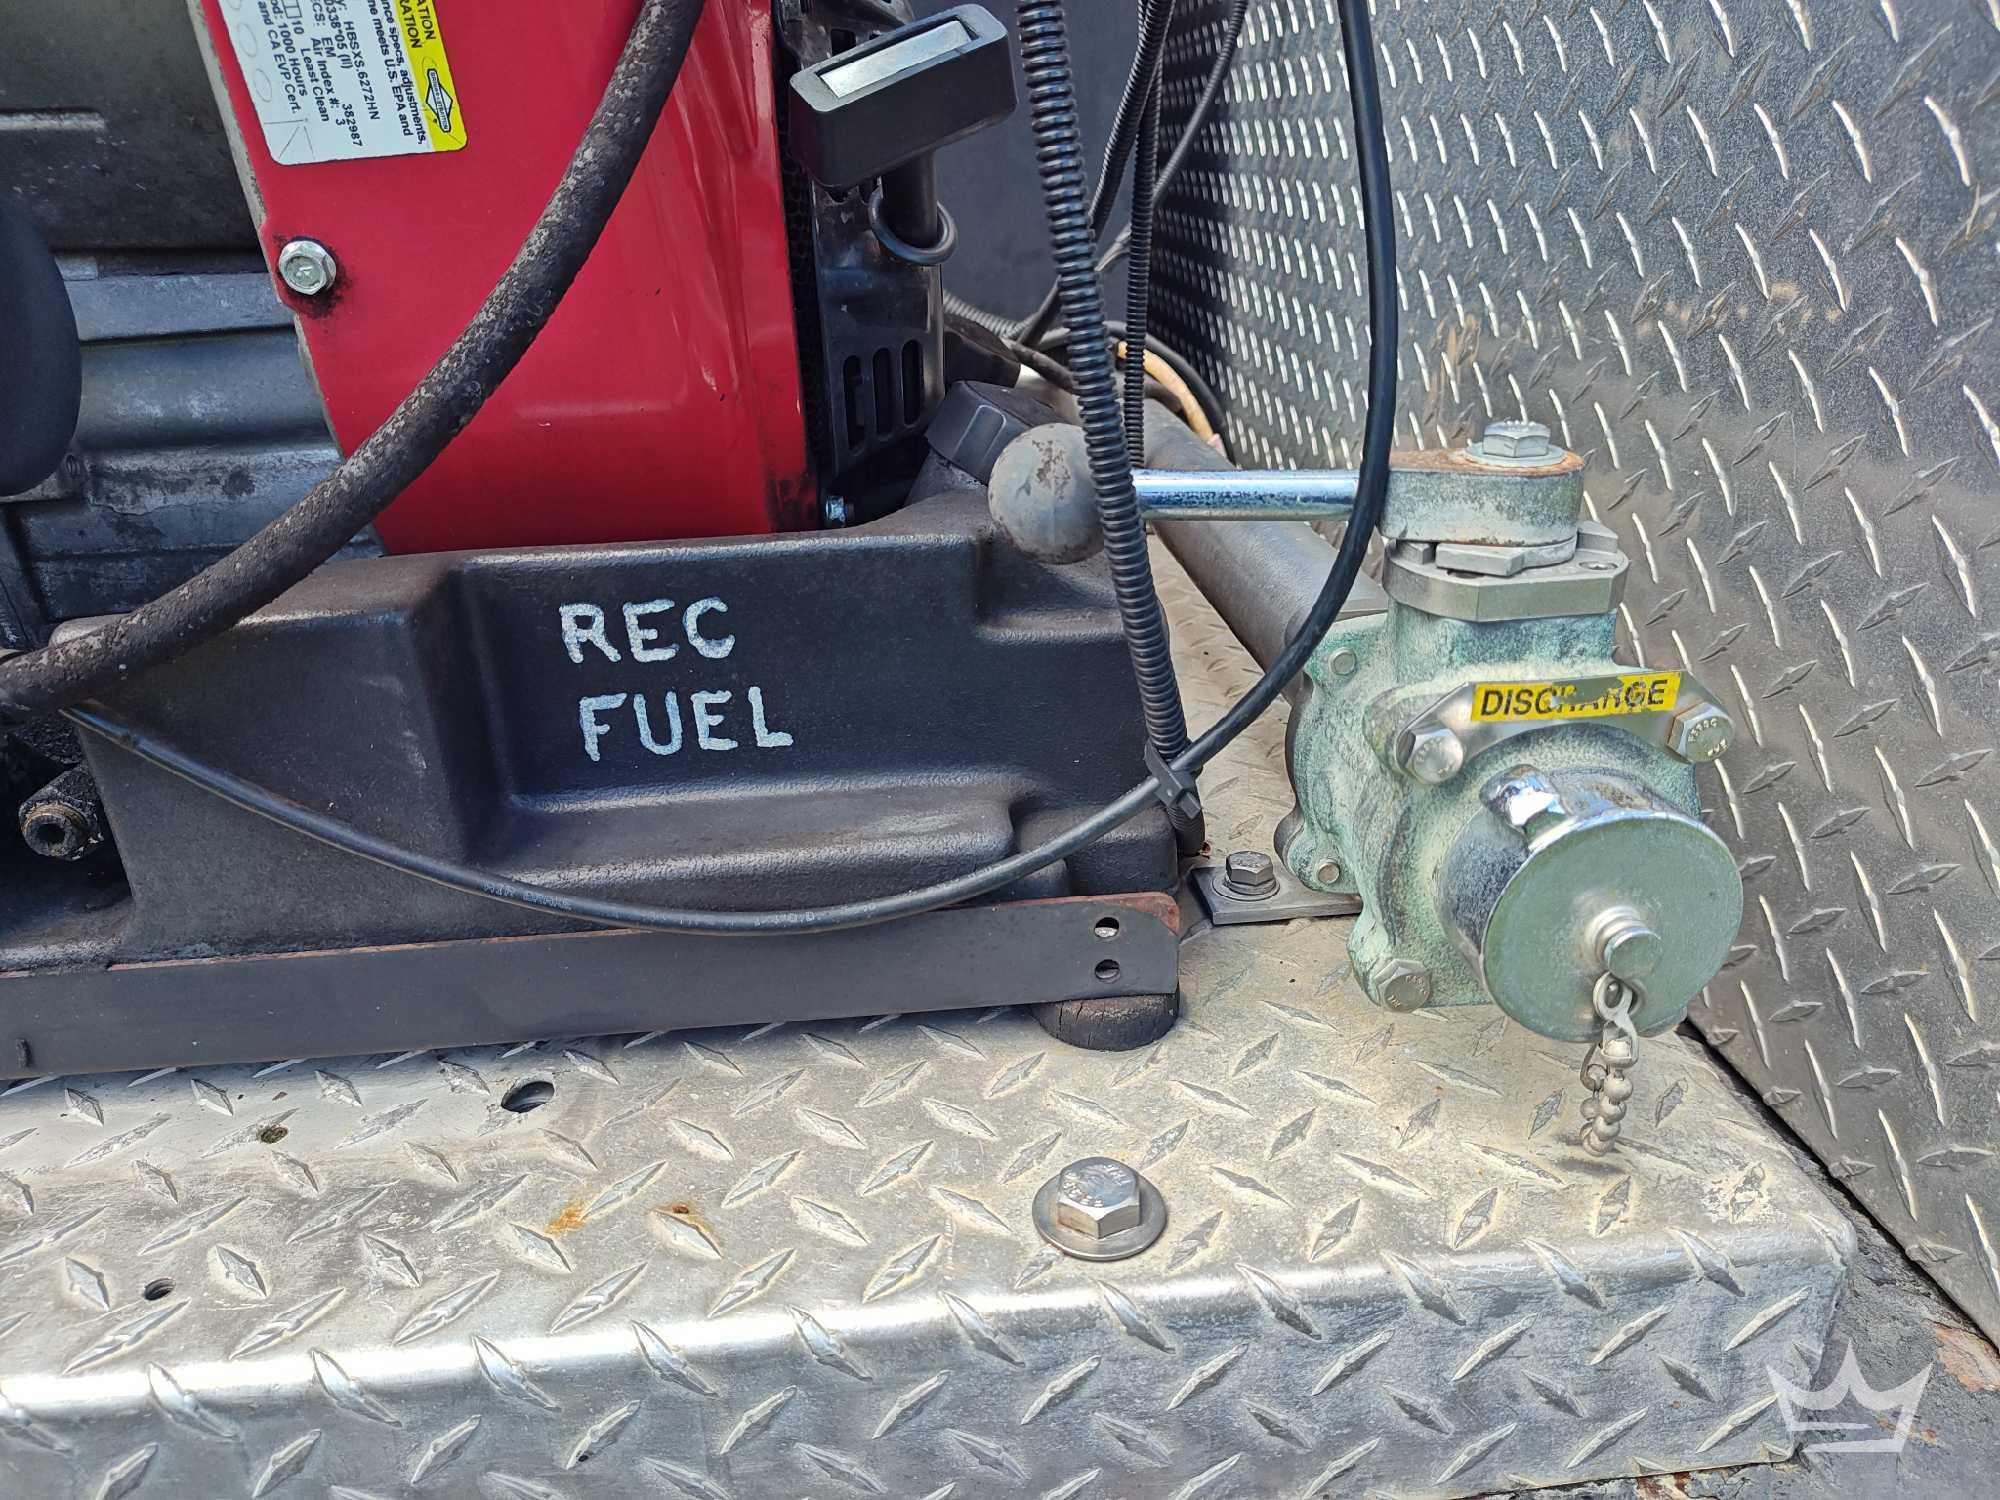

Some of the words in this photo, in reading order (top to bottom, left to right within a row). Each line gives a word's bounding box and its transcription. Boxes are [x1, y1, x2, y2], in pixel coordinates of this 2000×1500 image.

[258, 1, 273, 25] and
[311, 0, 326, 26] CS:
[321, 37, 336, 57] EM
[268, 29, 281, 50] CA
[372, 18, 389, 56] meets
[274, 54, 292, 80] EVP
[278, 22, 297, 54] 1000
[288, 58, 308, 97] Hours
[292, 21, 305, 35] 10
[300, 48, 321, 82] Least
[312, 86, 330, 121] Clean
[310, 38, 323, 57] Air
[317, 60, 335, 94] Index
[343, 21, 380, 120] HBSXS.6272HN
[384, 59, 398, 83] U.S.
[284, 83, 302, 114] Cert.
[389, 27, 405, 67] specs,
[400, 69, 426, 145] adjustments,
[392, 85, 406, 111] EPA
[341, 104, 363, 146] 382987
[398, 114, 413, 136] and
[559, 597, 736, 663] REC
[579, 686, 794, 761] FUEL
